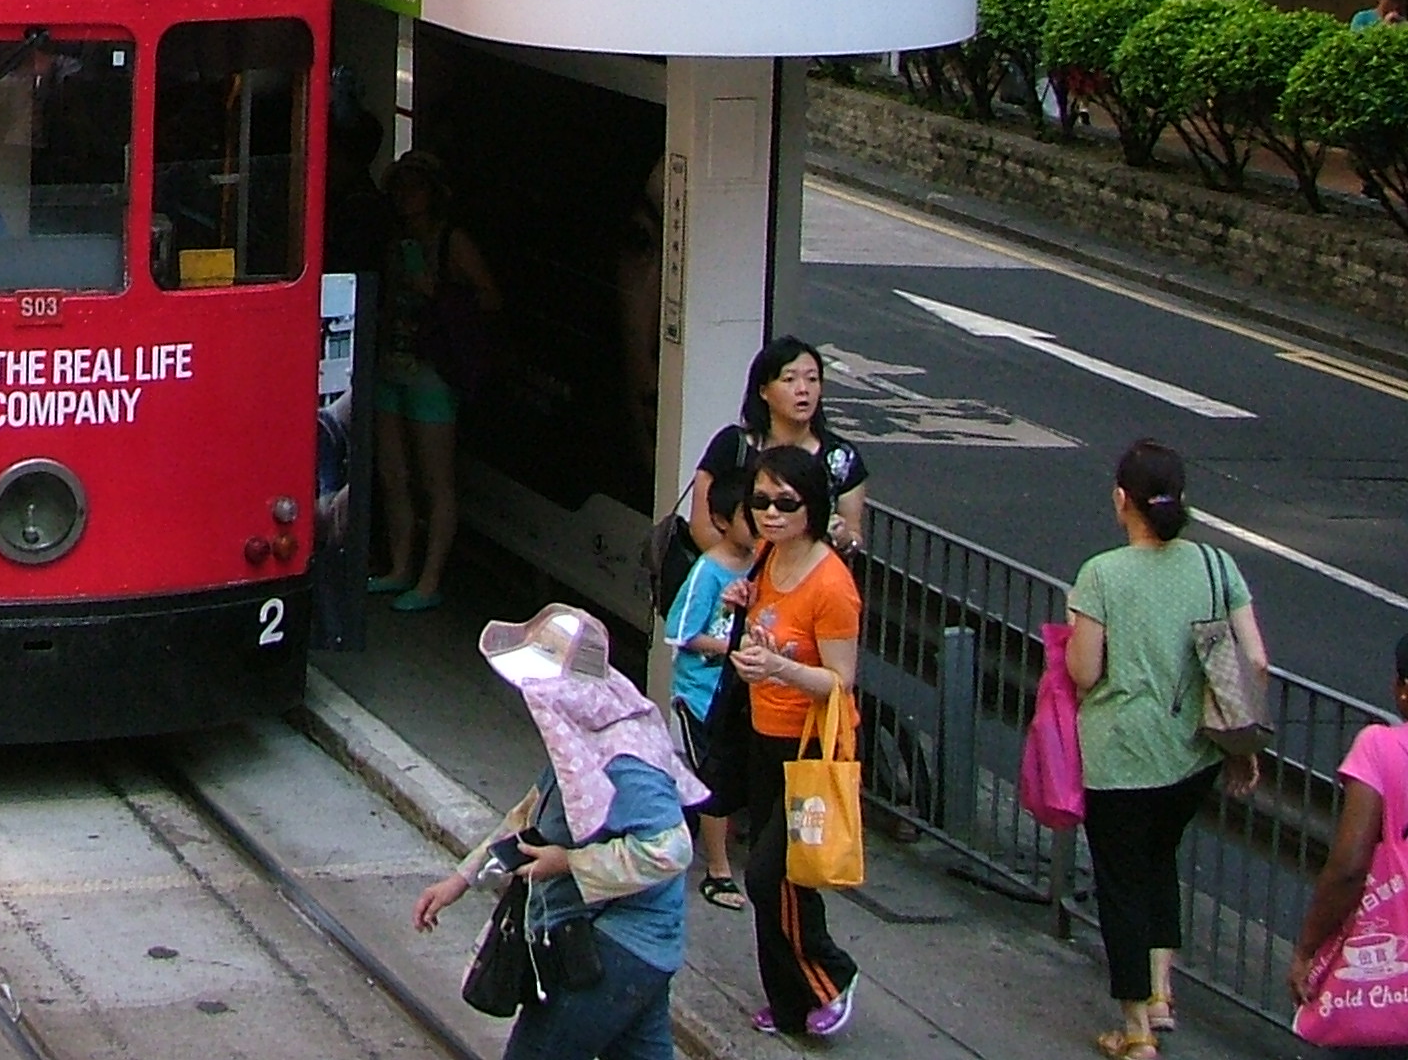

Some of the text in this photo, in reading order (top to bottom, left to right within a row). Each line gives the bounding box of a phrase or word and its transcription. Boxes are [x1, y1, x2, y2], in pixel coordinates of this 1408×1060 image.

[53, 347, 129, 384] REAL
[135, 343, 193, 381] LIFE
[259, 597, 285, 646] 2
